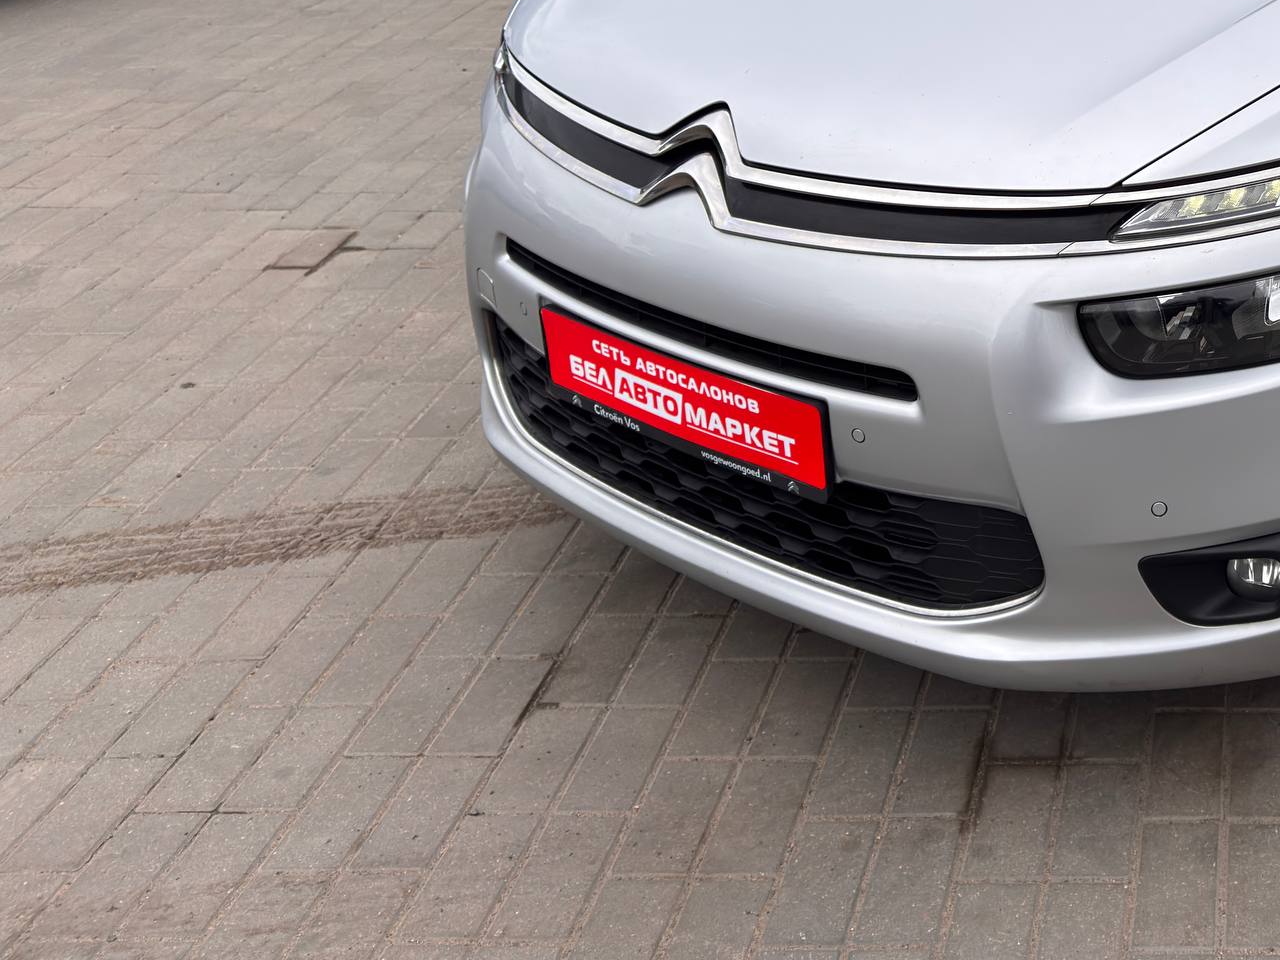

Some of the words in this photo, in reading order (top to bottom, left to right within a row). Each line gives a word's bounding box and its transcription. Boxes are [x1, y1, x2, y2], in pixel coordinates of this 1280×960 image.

[591, 339, 632, 367] СЕТЬ
[635, 357, 761, 414] АВТОСАЛОНОВ
[569, 354, 613, 390] БЕЛ
[618, 375, 679, 419] АВТО
[684, 402, 796, 458] МАРКЕТ
[594, 404, 624, 424] Citroën
[624, 416, 641, 432] Vos
[701, 450, 772, 482] vosgewoongoed.nl
